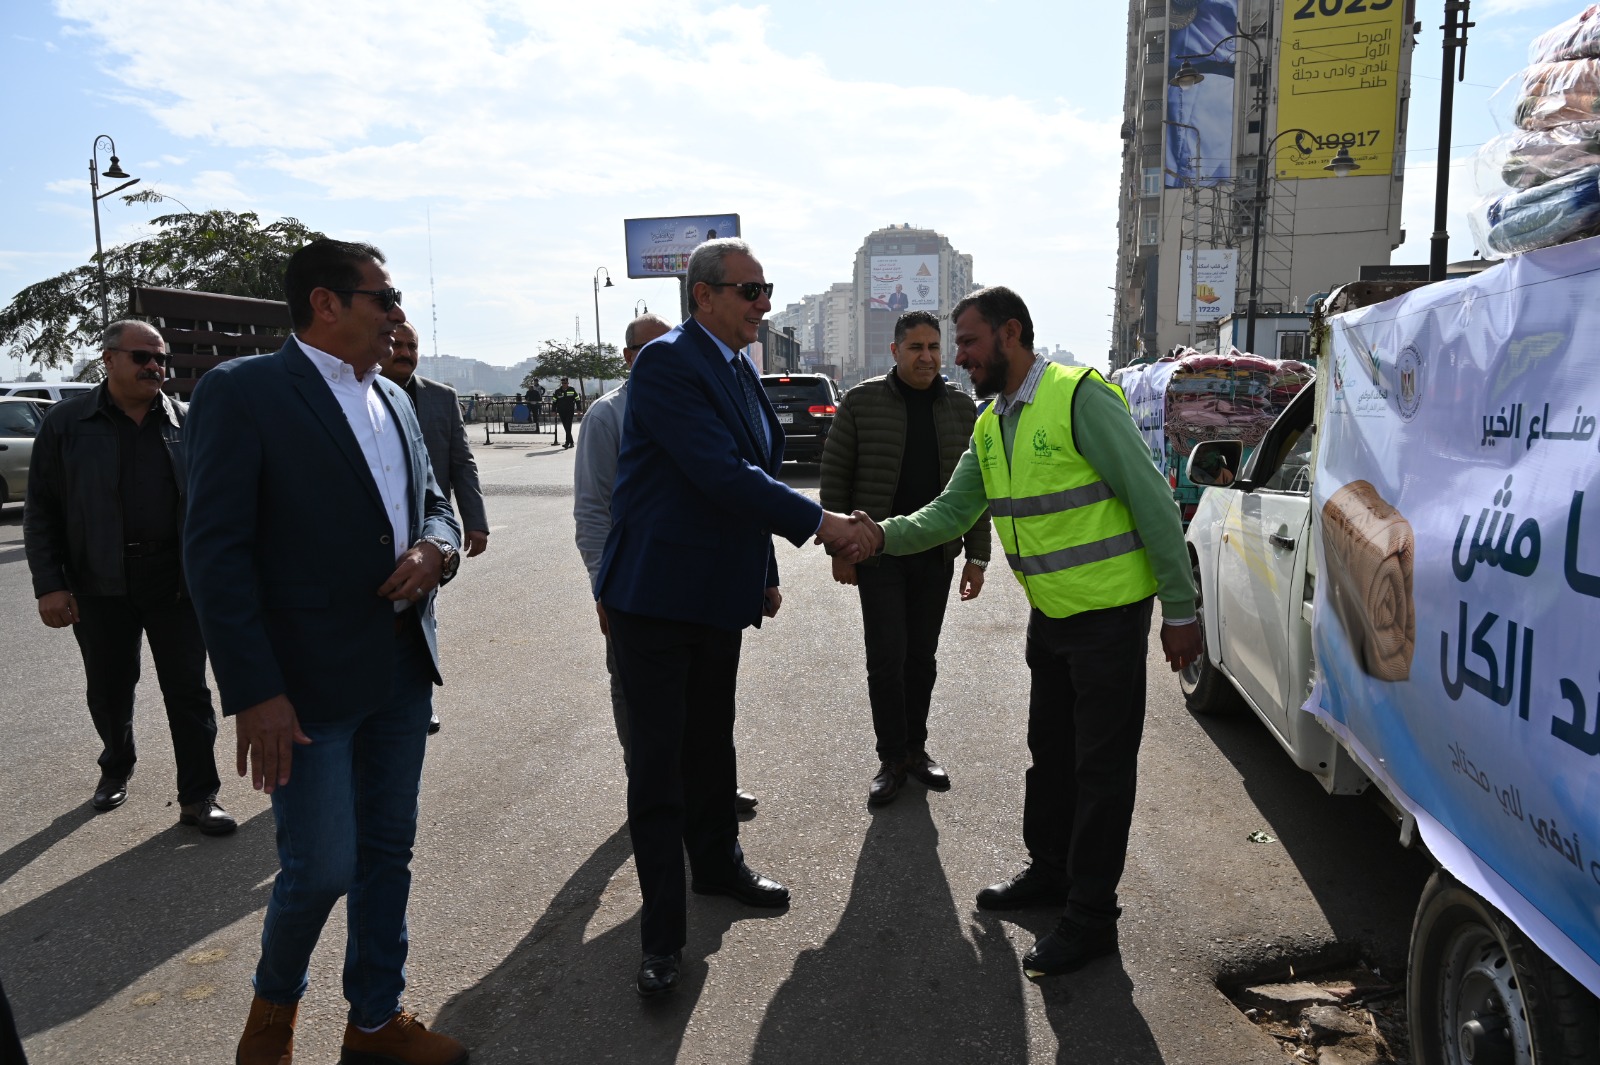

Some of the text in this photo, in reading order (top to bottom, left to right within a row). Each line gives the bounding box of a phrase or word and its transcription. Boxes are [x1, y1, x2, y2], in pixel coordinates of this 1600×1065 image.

[1292, 28, 1392, 50] المرحلة
[1292, 68, 1319, 82] دجلة
[1359, 60, 1388, 76] نادي
[1291, 75, 1387, 96] طنطا
[1315, 130, 1381, 151] 19917
[1480, 402, 1597, 451] صناع الخير
[1451, 473, 1542, 583] مش
[1439, 599, 1535, 722] الكل
[1447, 740, 1491, 794] محتاج
[1494, 783, 1524, 822] للي
